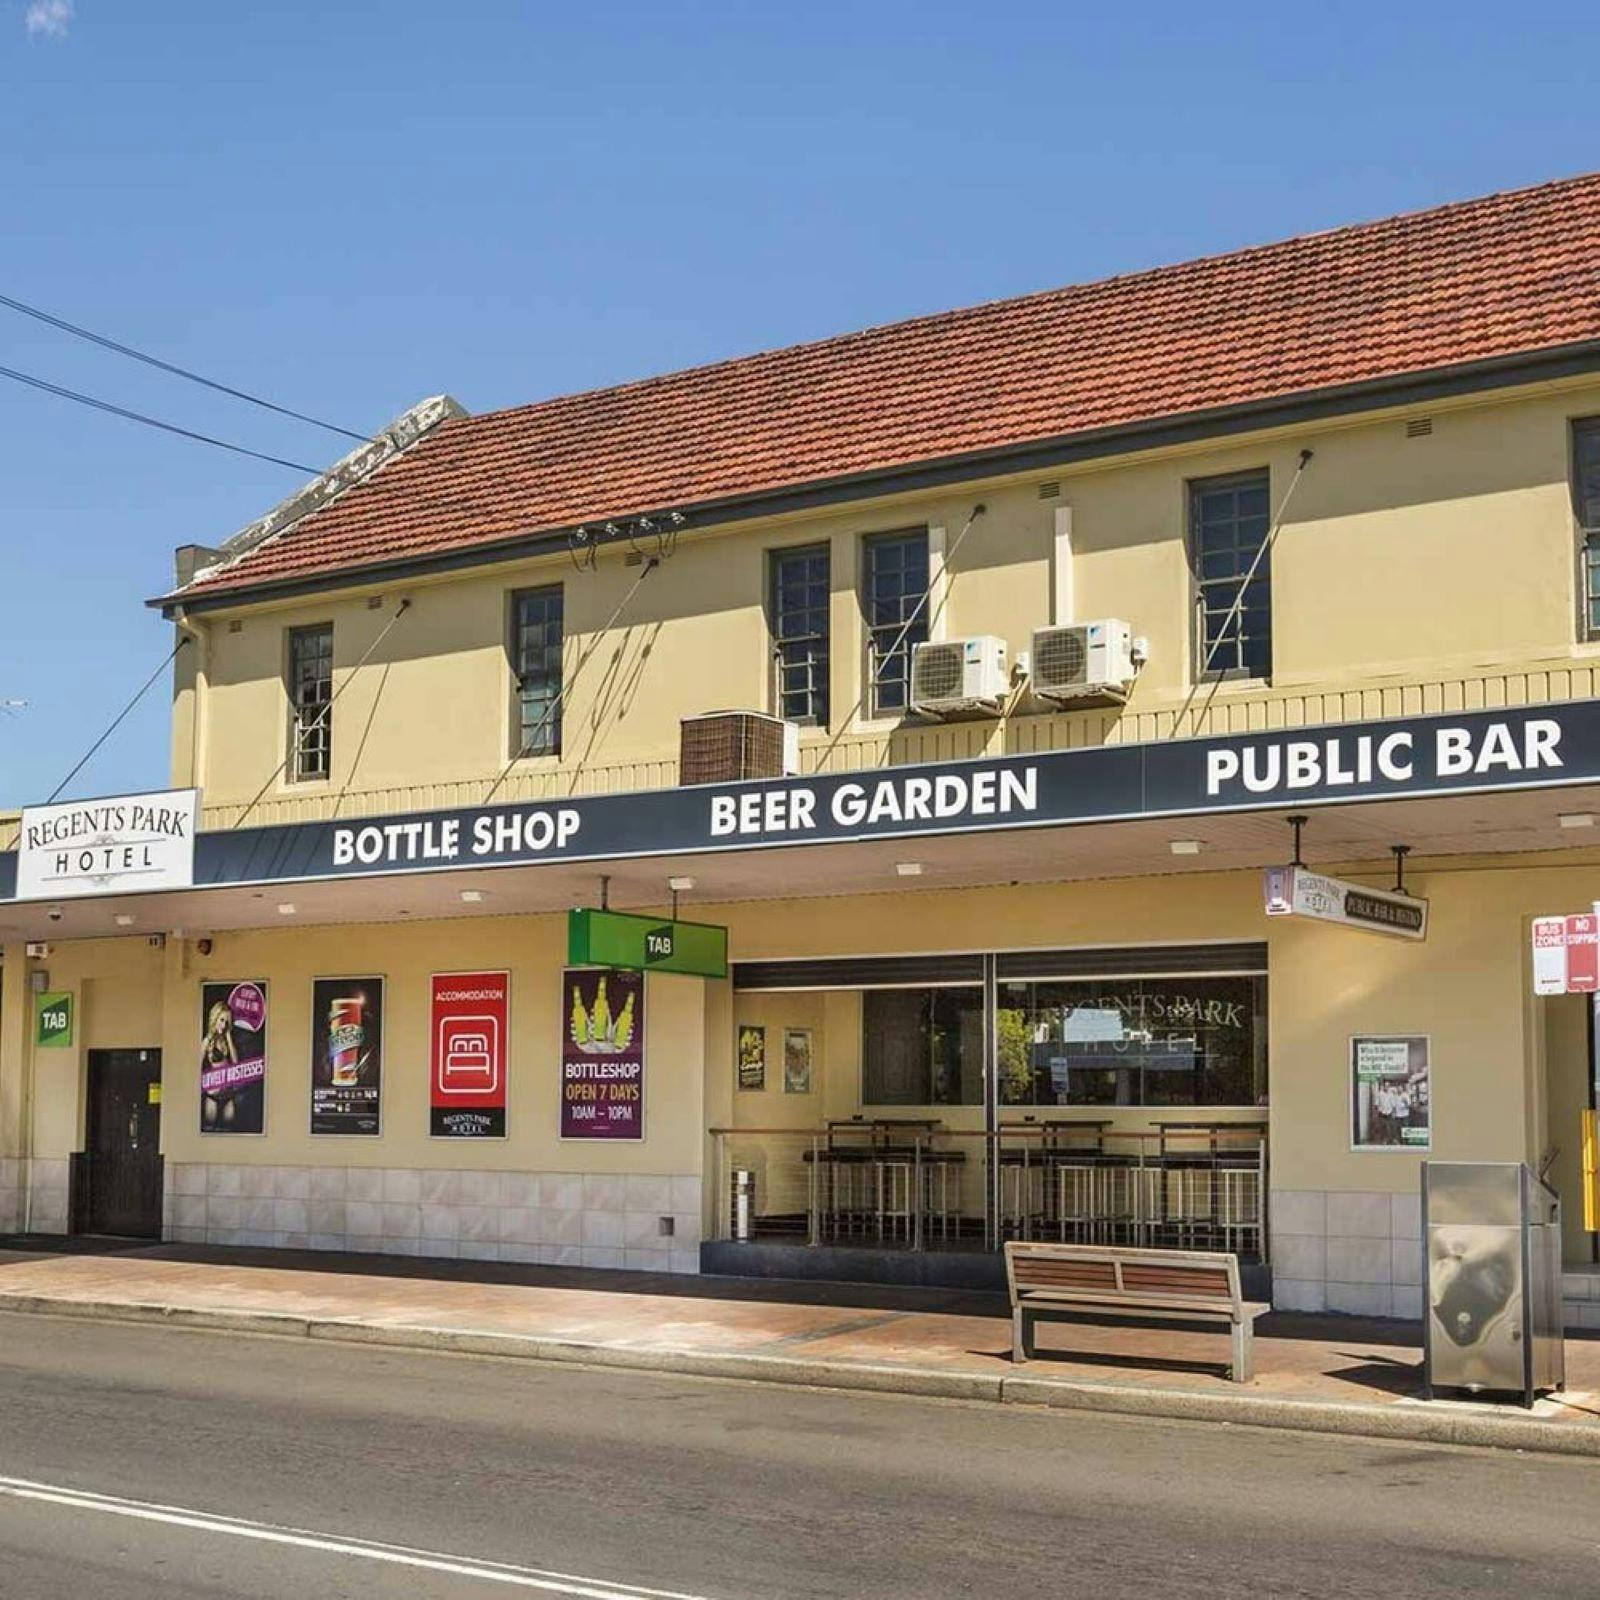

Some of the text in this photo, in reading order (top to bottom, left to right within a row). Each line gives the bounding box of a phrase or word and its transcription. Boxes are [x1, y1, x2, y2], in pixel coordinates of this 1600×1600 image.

[1207, 720, 1564, 795] PUBLIC BAR
[711, 768, 1037, 836] BEER GARDEN
[27, 805, 188, 850] REGENTS PARK
[333, 809, 581, 865] BOTTLE SHOP
[56, 846, 152, 873] HOTEL
[1538, 924, 1560, 935] BUS
[1575, 919, 1589, 931] NO
[647, 936, 671, 954] TAB
[436, 989, 503, 1001] ACCOMMODATION
[1173, 995, 1246, 1028] PARK
[43, 1012, 66, 1029] TAB
[566, 1063, 640, 1079] BOTTLESHOP
[566, 1084, 639, 1101] OPEN 7 DAYS
[474, 1115, 491, 1127] PARK
[572, 1106, 596, 1120] 10AM
[608, 1106, 632, 1120] 10PM
